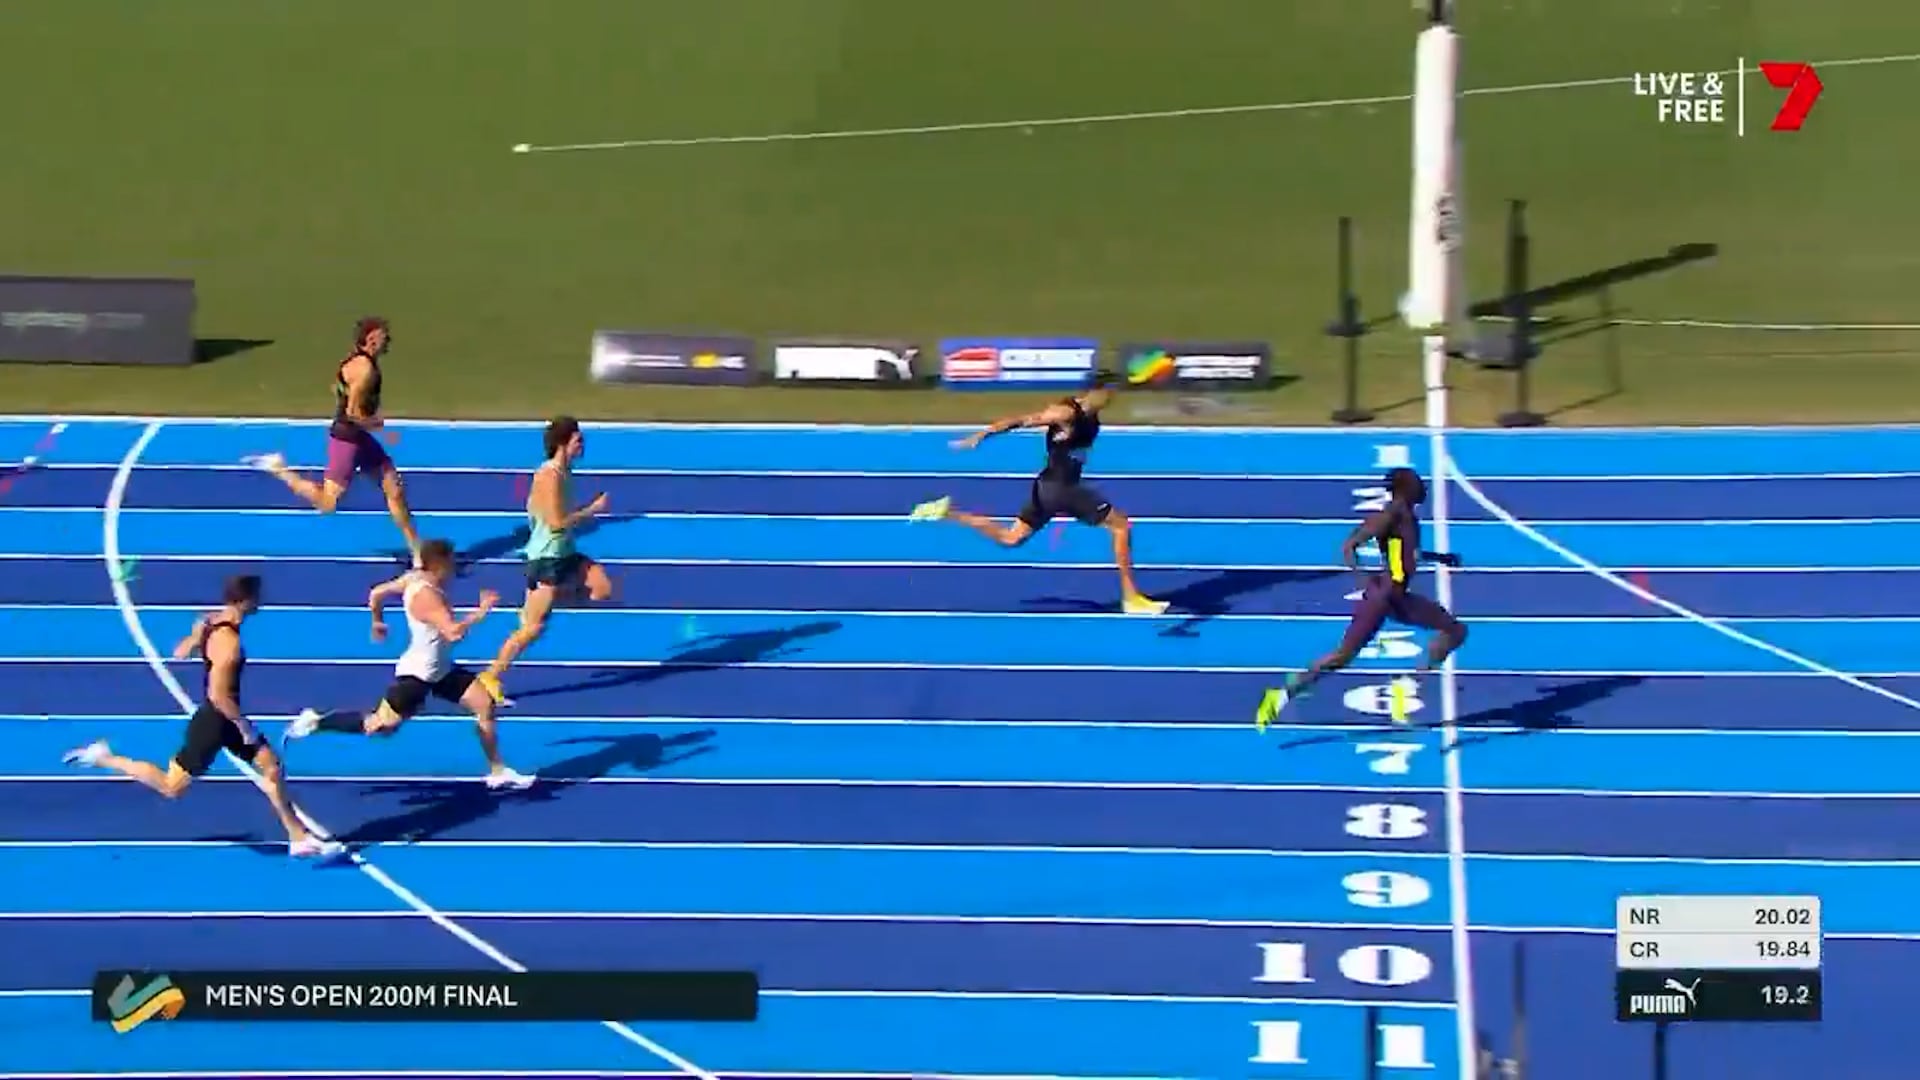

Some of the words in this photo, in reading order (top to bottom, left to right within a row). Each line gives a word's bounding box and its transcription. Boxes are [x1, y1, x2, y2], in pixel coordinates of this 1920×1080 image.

[1355, 742, 1426, 775] 7
[1344, 802, 1429, 840] 8
[1341, 870, 1432, 909] 9
[1251, 941, 1434, 987] 10
[1247, 1019, 1436, 1069] 11
